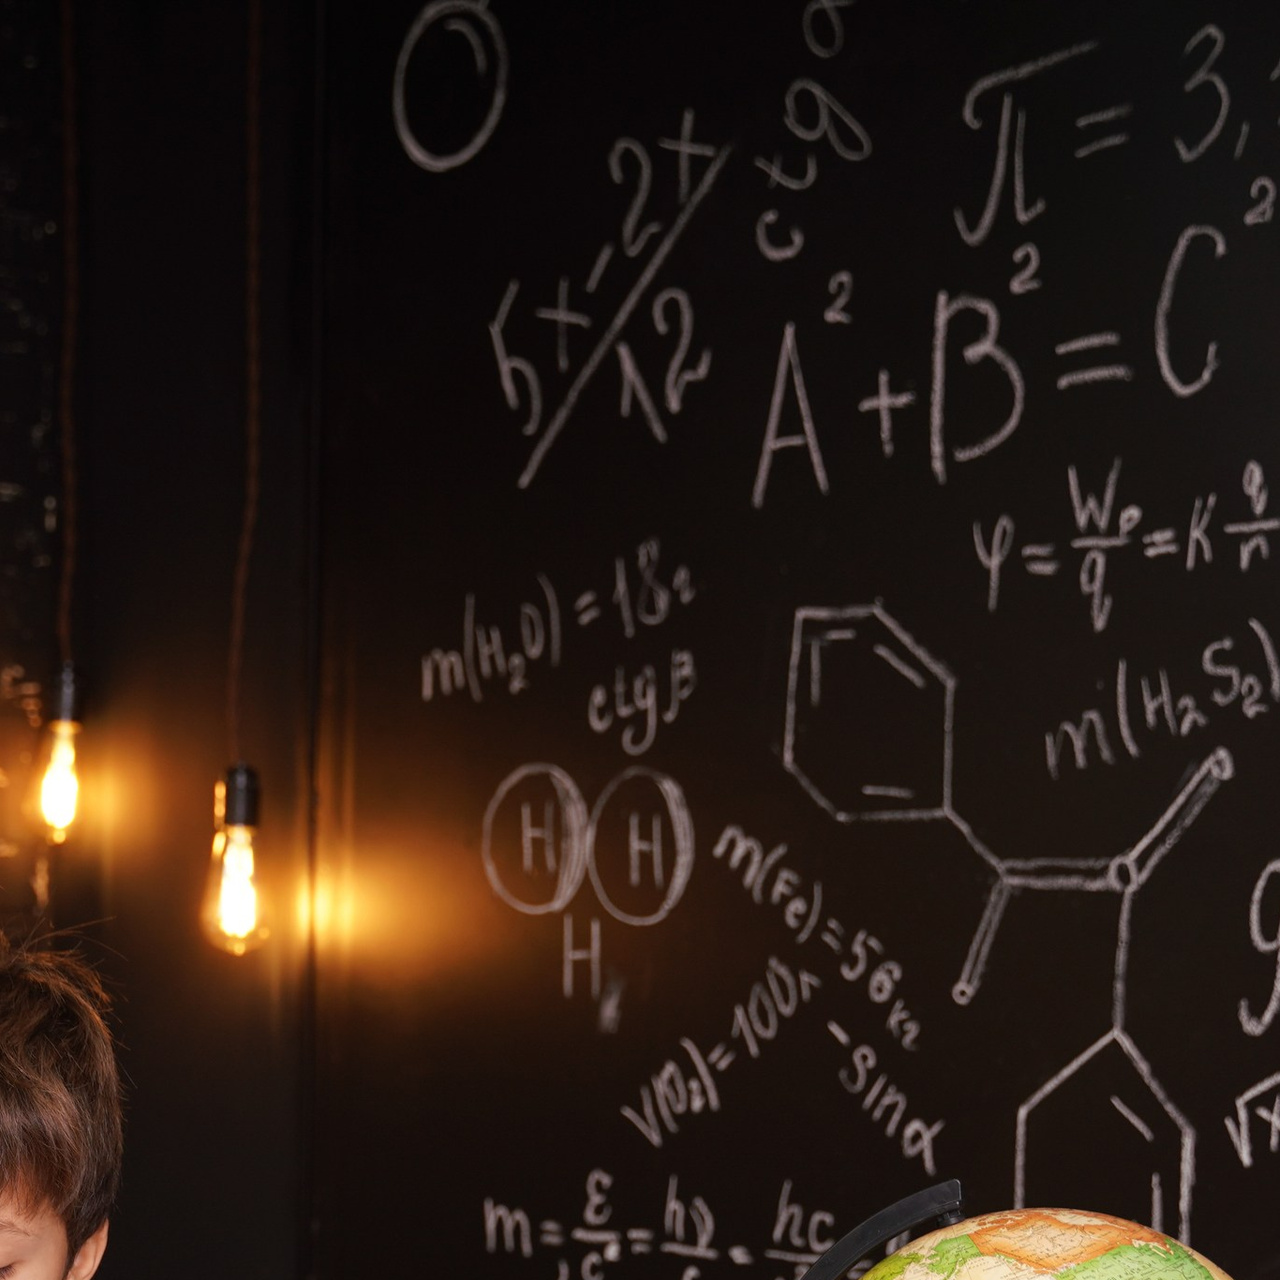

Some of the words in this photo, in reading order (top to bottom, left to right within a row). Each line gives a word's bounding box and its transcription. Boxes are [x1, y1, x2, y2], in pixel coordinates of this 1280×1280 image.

[520, 800, 557, 876] H
[628, 810, 664, 889] H
[562, 911, 602, 1000] H
